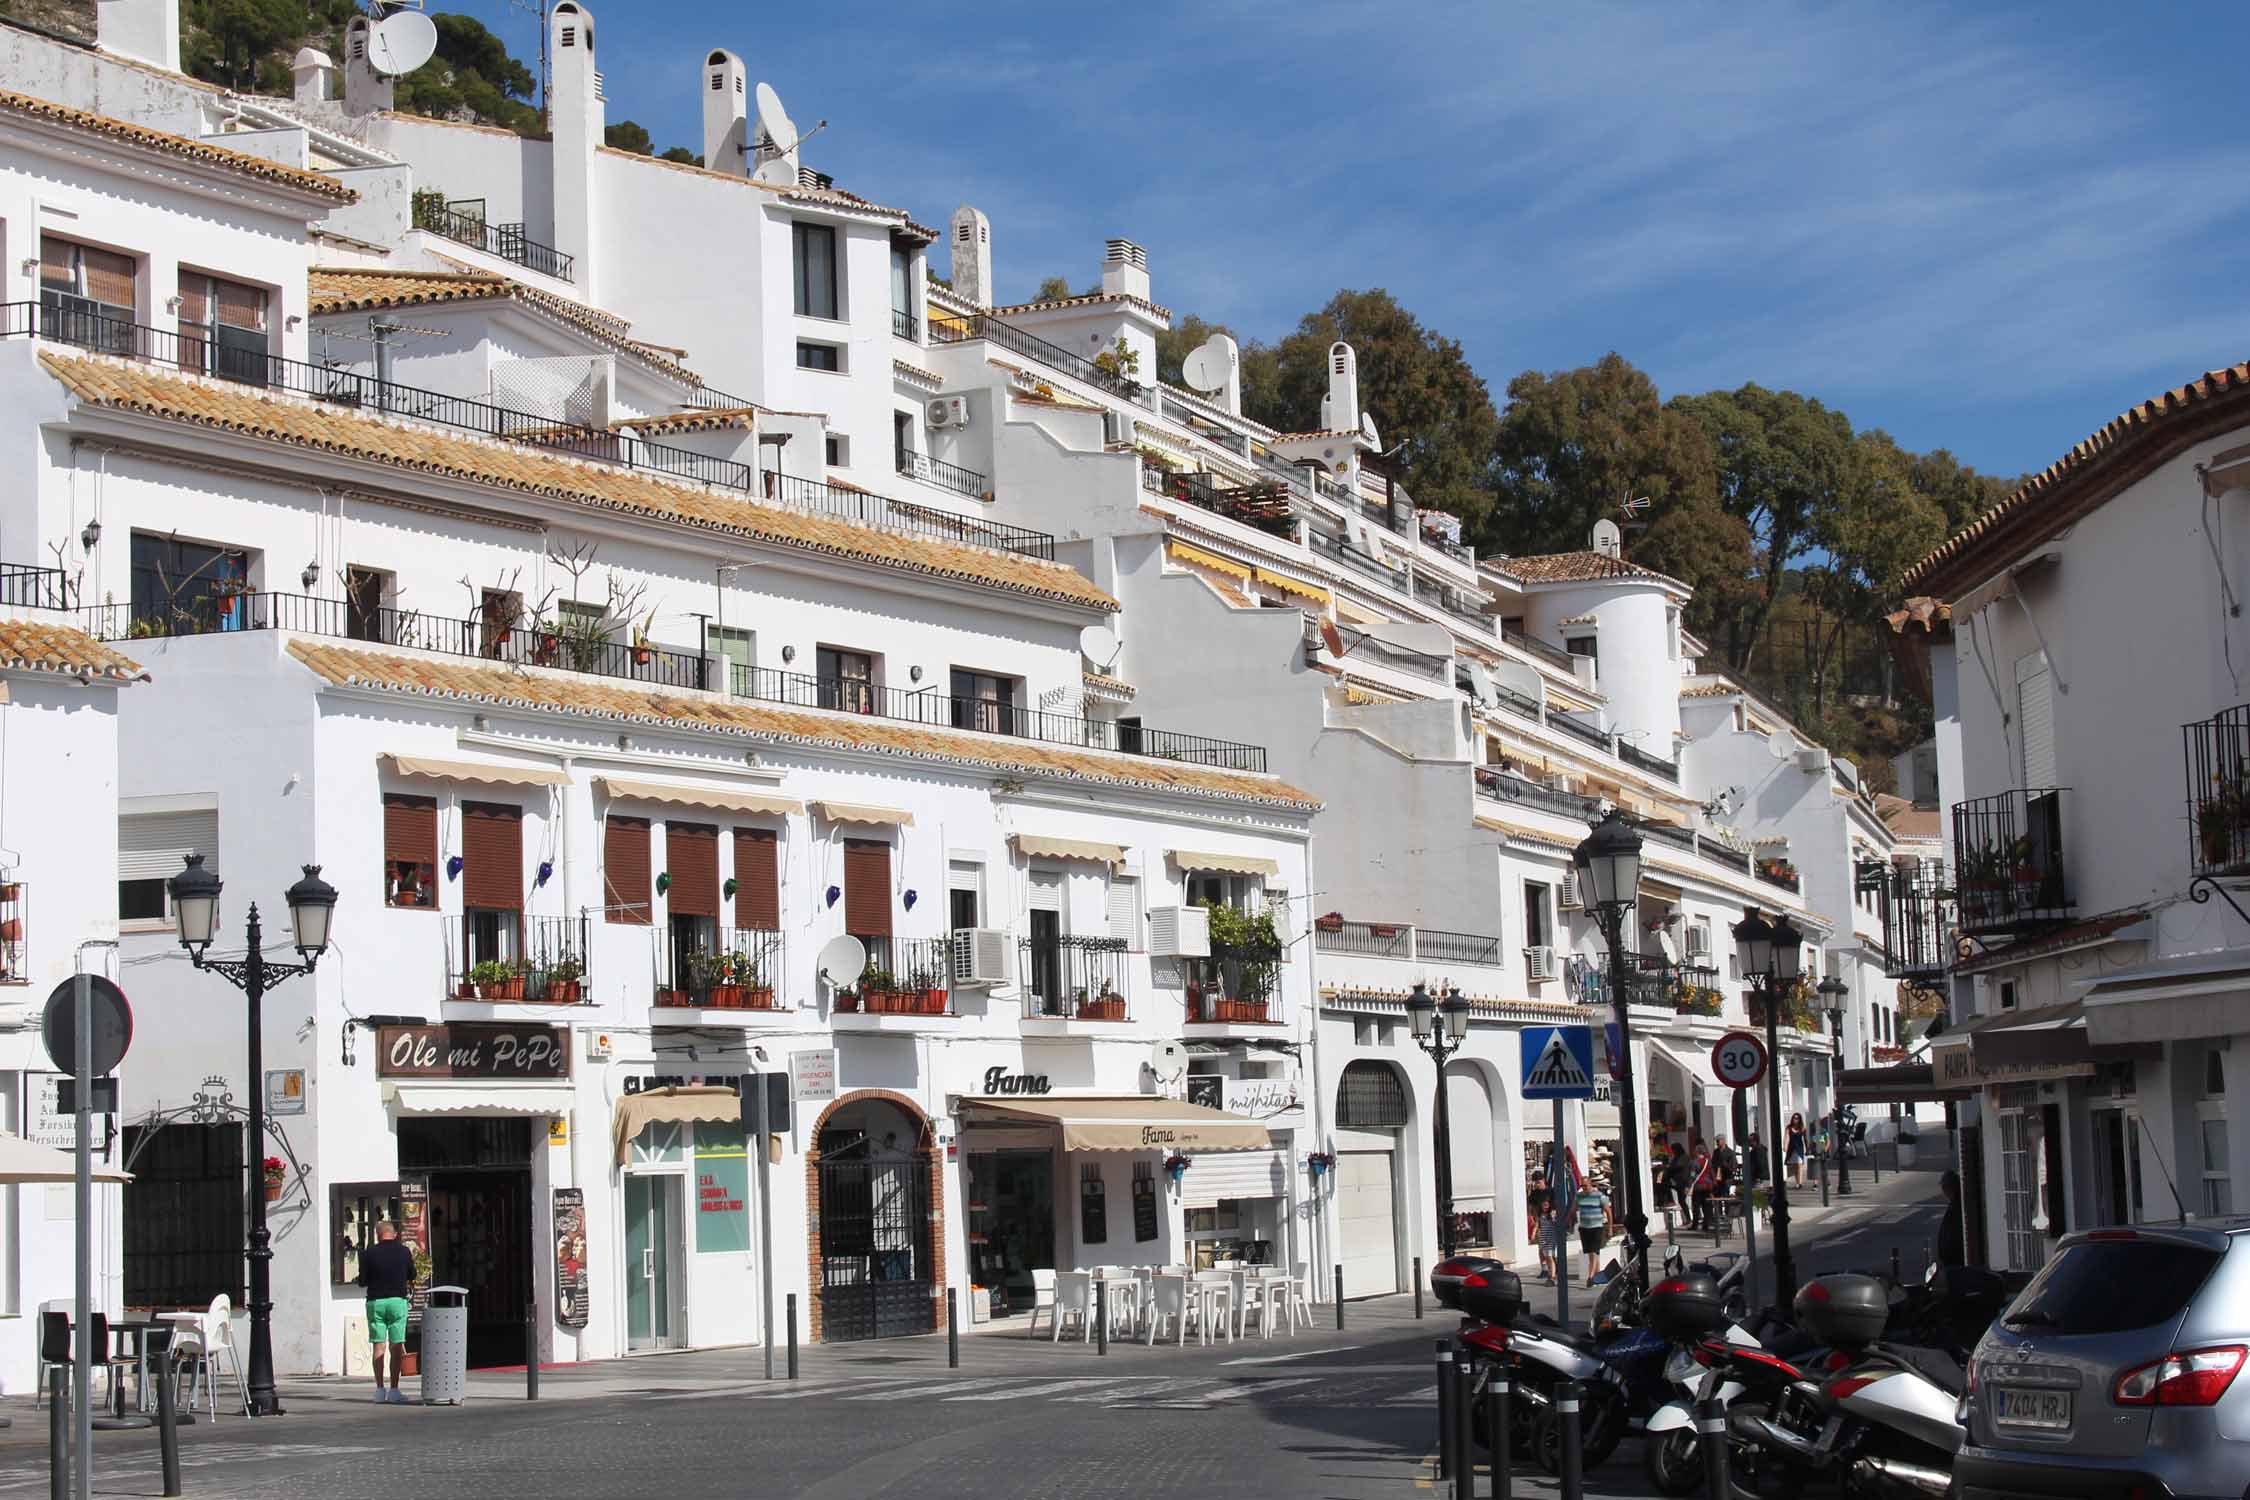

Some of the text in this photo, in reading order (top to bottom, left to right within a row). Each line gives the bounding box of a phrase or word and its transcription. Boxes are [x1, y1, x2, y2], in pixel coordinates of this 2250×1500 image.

[390, 1032, 560, 1072] Ole mi PePe
[1723, 1050, 1755, 1070] 30
[984, 1066, 1052, 1095] Fama
[1142, 1126, 1175, 1145] Fama
